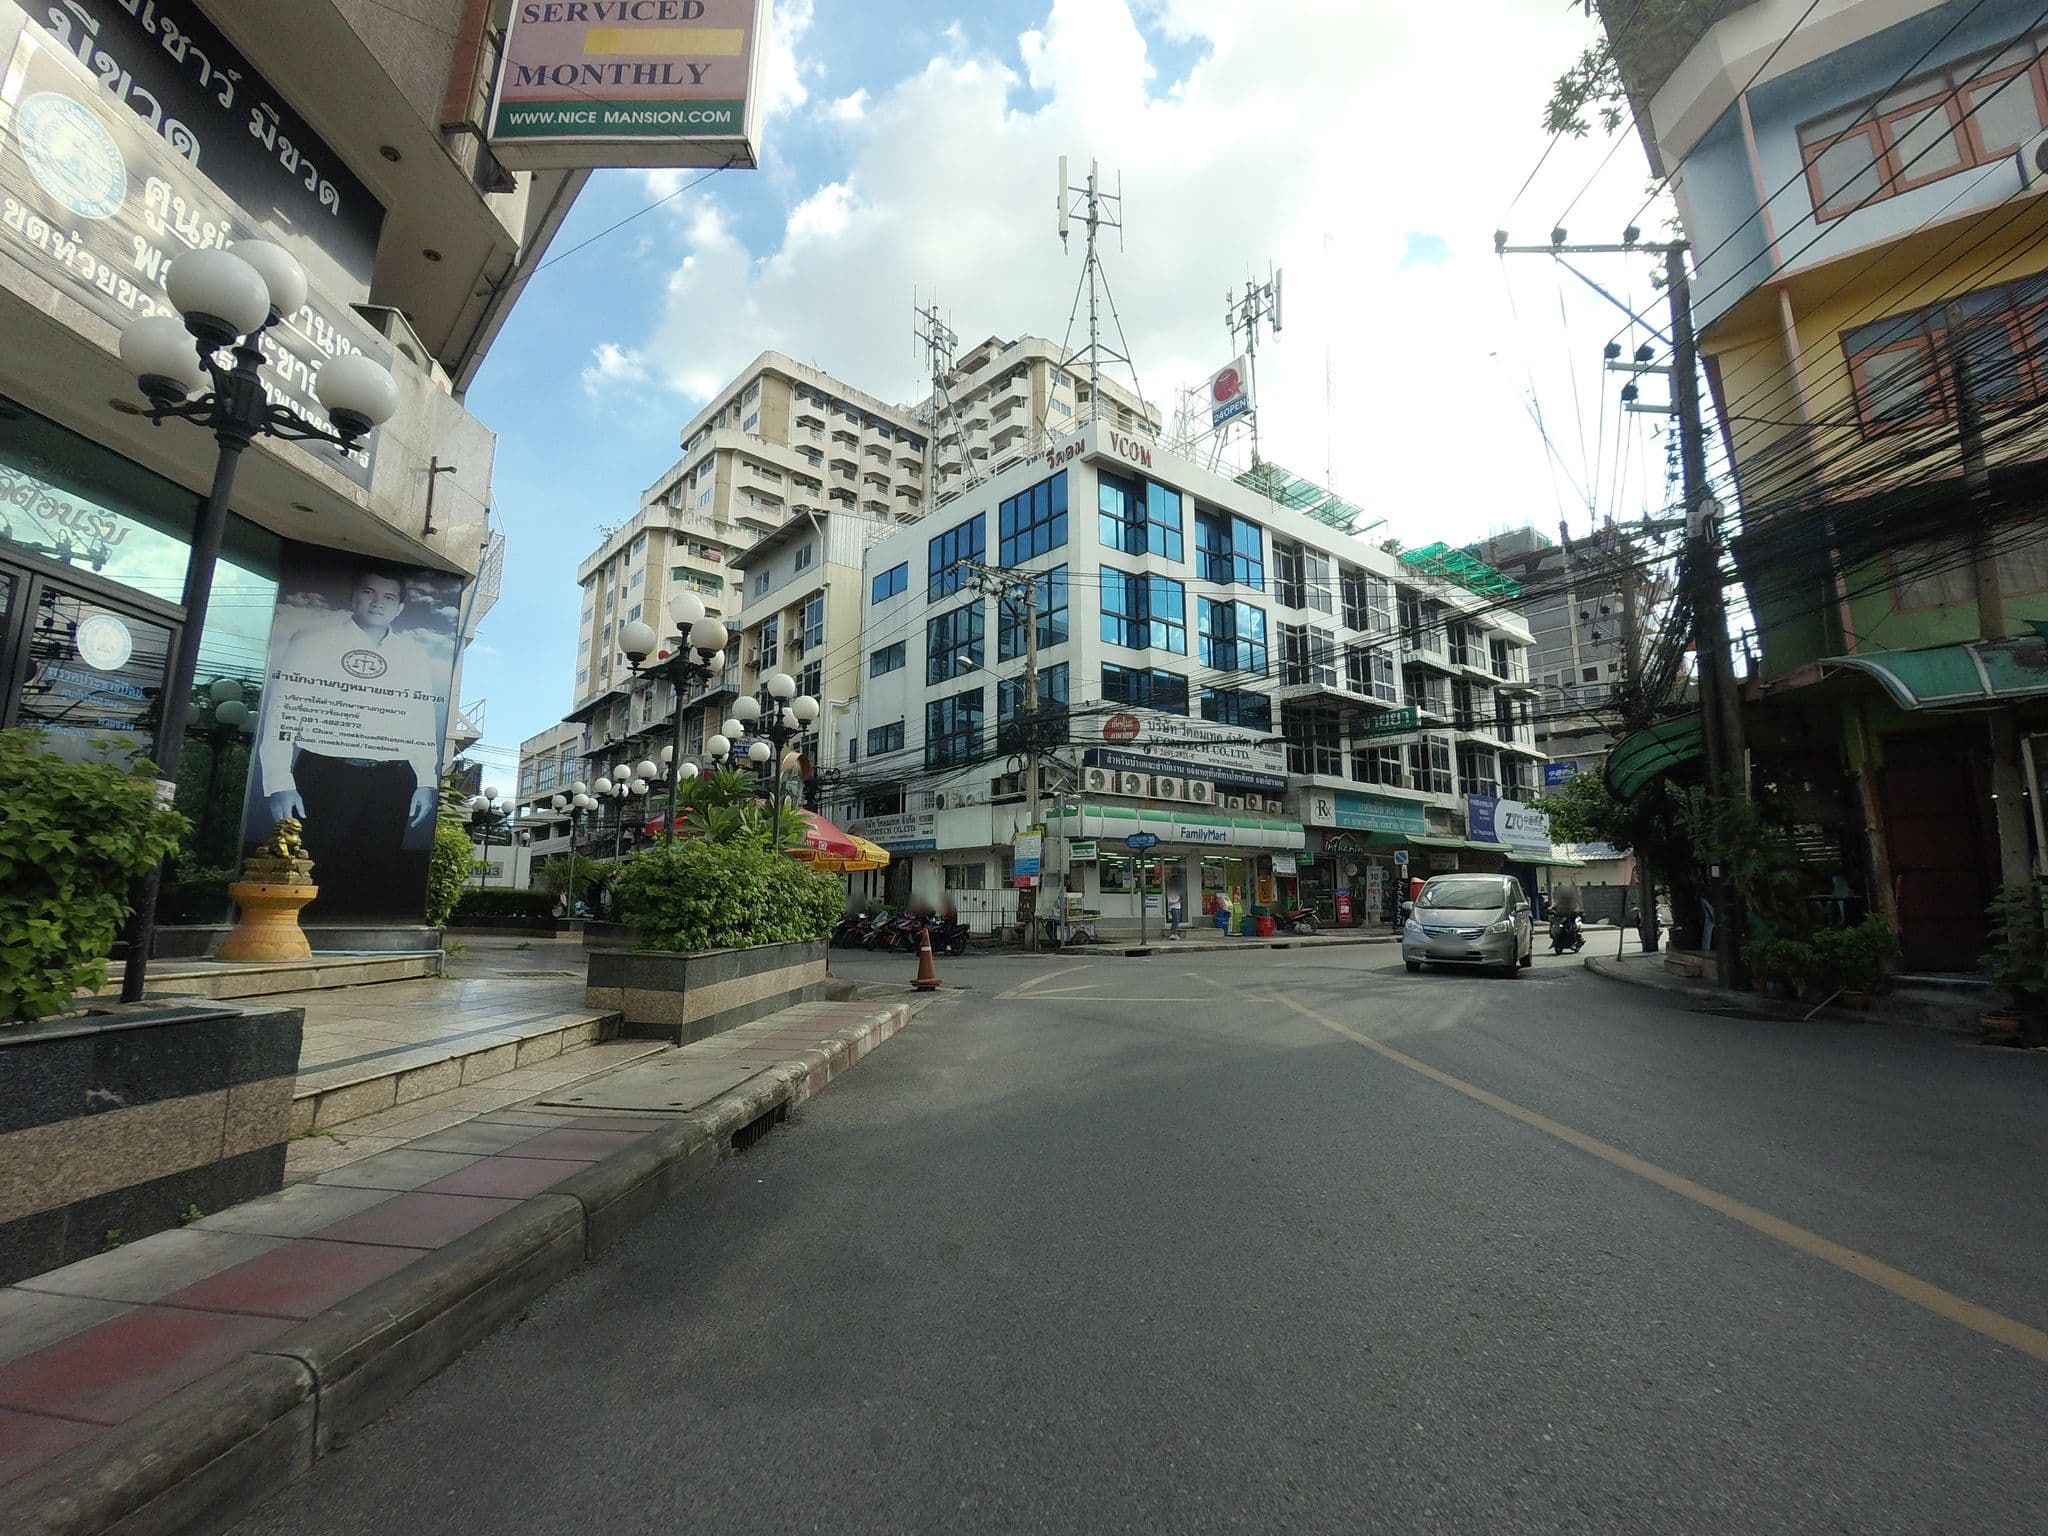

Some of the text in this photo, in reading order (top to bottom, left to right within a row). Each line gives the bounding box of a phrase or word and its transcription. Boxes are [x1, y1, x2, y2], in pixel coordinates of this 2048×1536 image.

[521, 0, 705, 24] SERVICED
[514, 63, 712, 87] MONTHLY
[509, 110, 731, 125] WWW.NICE MANSION.COM
[248, 102, 339, 216] มีขวด
[1109, 430, 1152, 469] VCOM
[1181, 827, 1226, 842] FamilyMart
